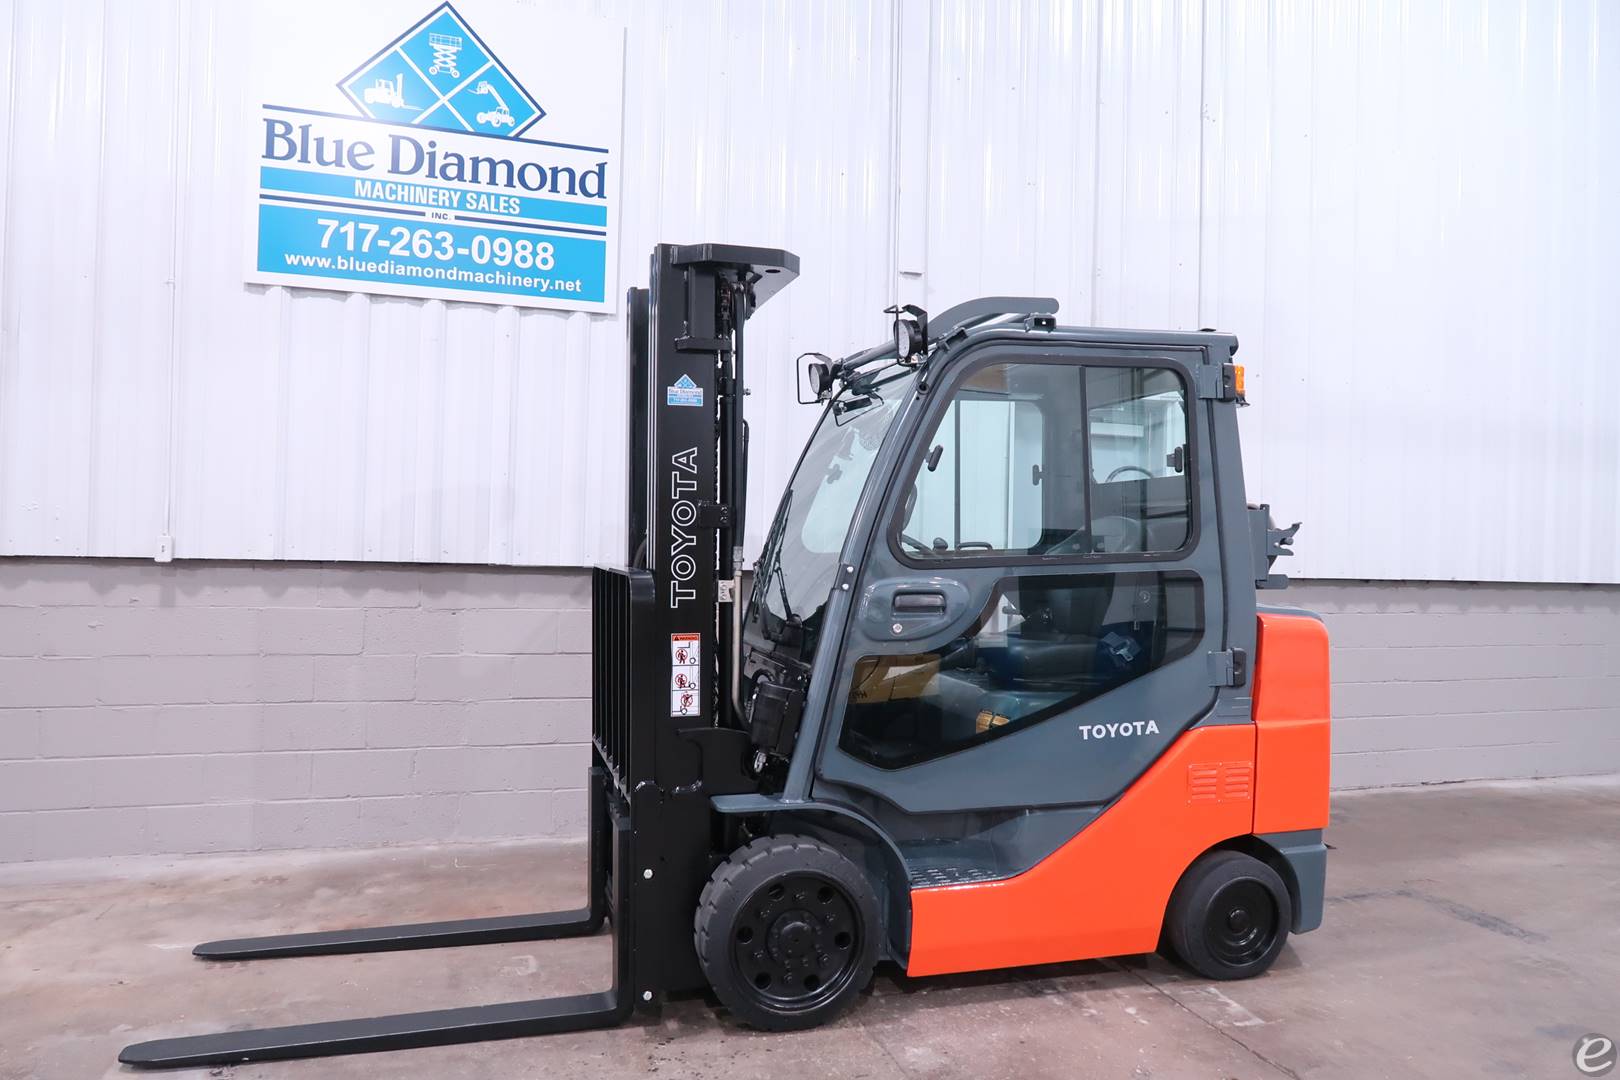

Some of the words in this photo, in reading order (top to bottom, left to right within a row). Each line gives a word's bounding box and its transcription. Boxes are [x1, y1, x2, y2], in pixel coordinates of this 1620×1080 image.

[261, 118, 375, 171] Blue
[387, 134, 608, 199] Diamond
[354, 179, 462, 208] MACHINERY
[465, 192, 521, 214] SALES
[431, 212, 451, 221] INC.
[317, 218, 555, 271] 717-263-0988
[284, 253, 582, 292] www.bluediamondmachinery.net
[670, 447, 698, 609] TOYOTA
[1078, 720, 1160, 740] TOYOTA
